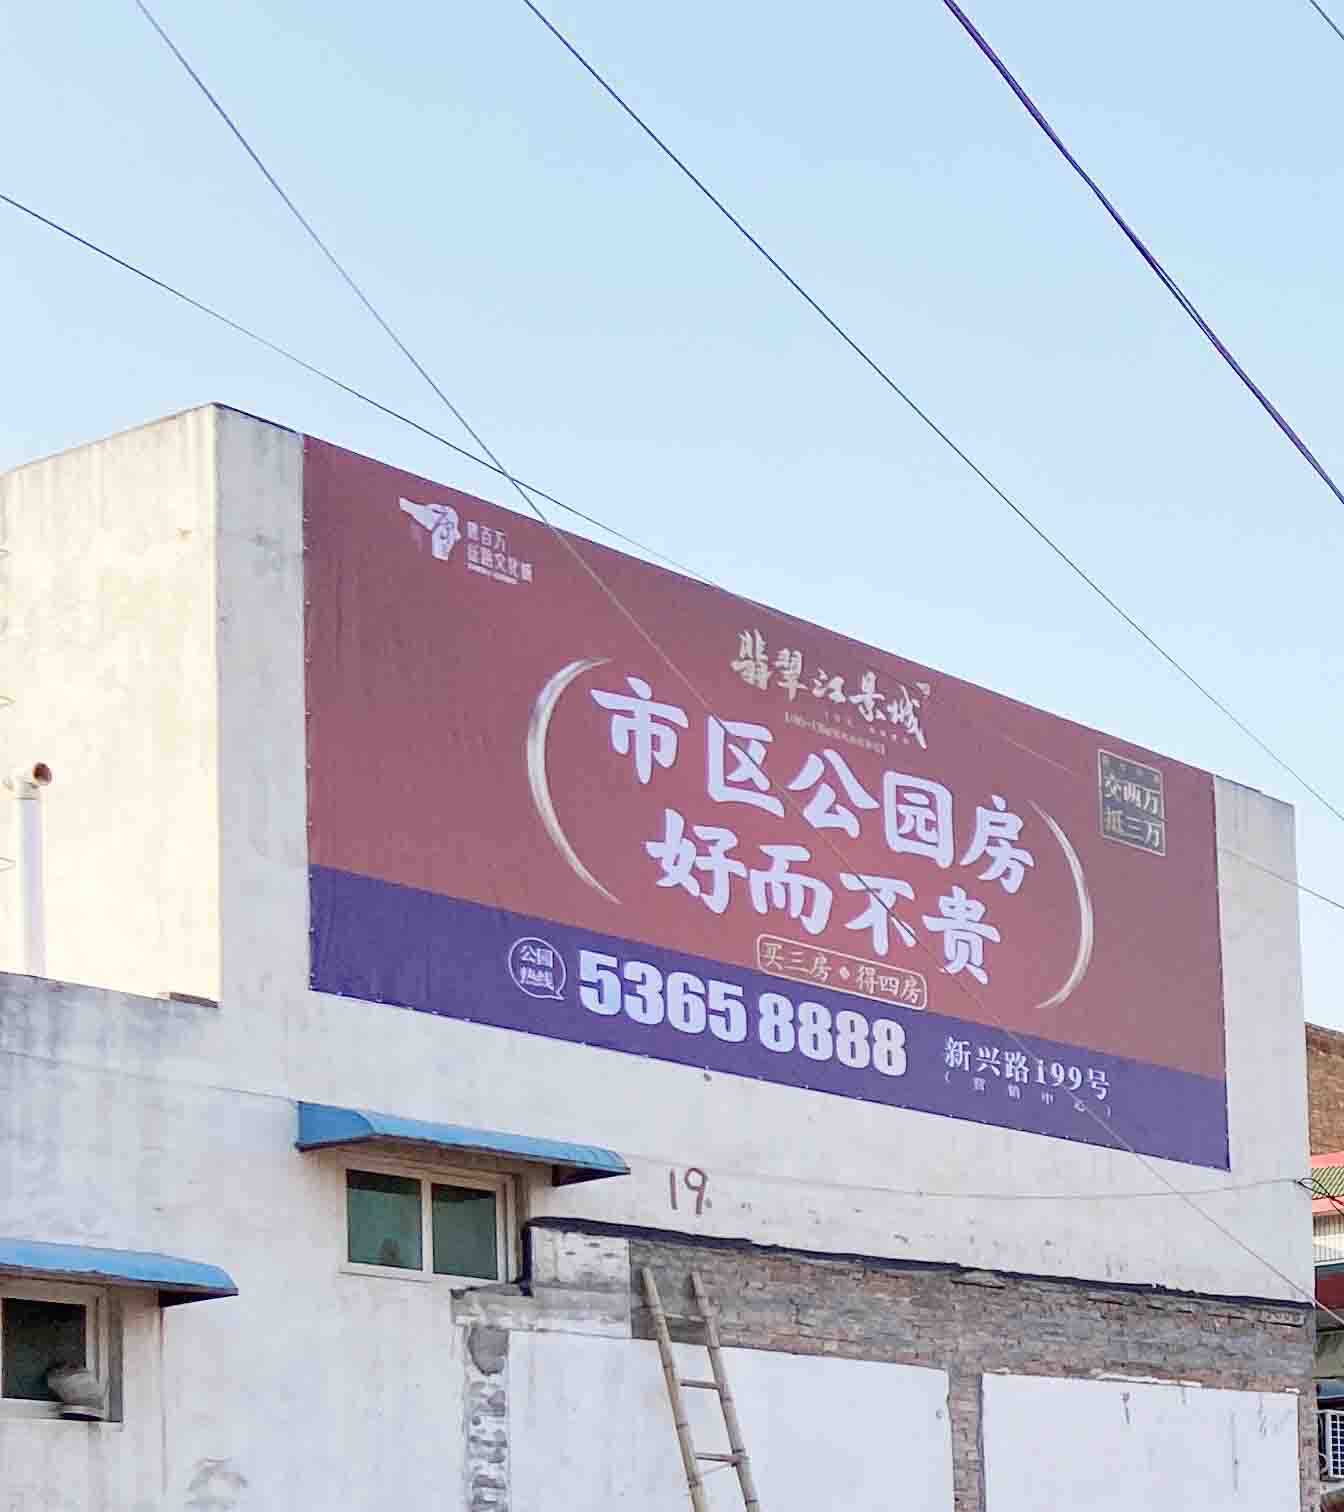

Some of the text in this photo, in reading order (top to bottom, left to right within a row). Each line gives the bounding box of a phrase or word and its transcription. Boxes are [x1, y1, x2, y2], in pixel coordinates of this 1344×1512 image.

[729, 629, 931, 751] 翡翠江景城
[591, 676, 1034, 894] 市区公园房
[645, 809, 1001, 985] 好而不贵
[579, 950, 907, 1077] 5365 8888
[944, 1036, 1111, 1101] 新兴路199号
[669, 1167, 706, 1215] 19
